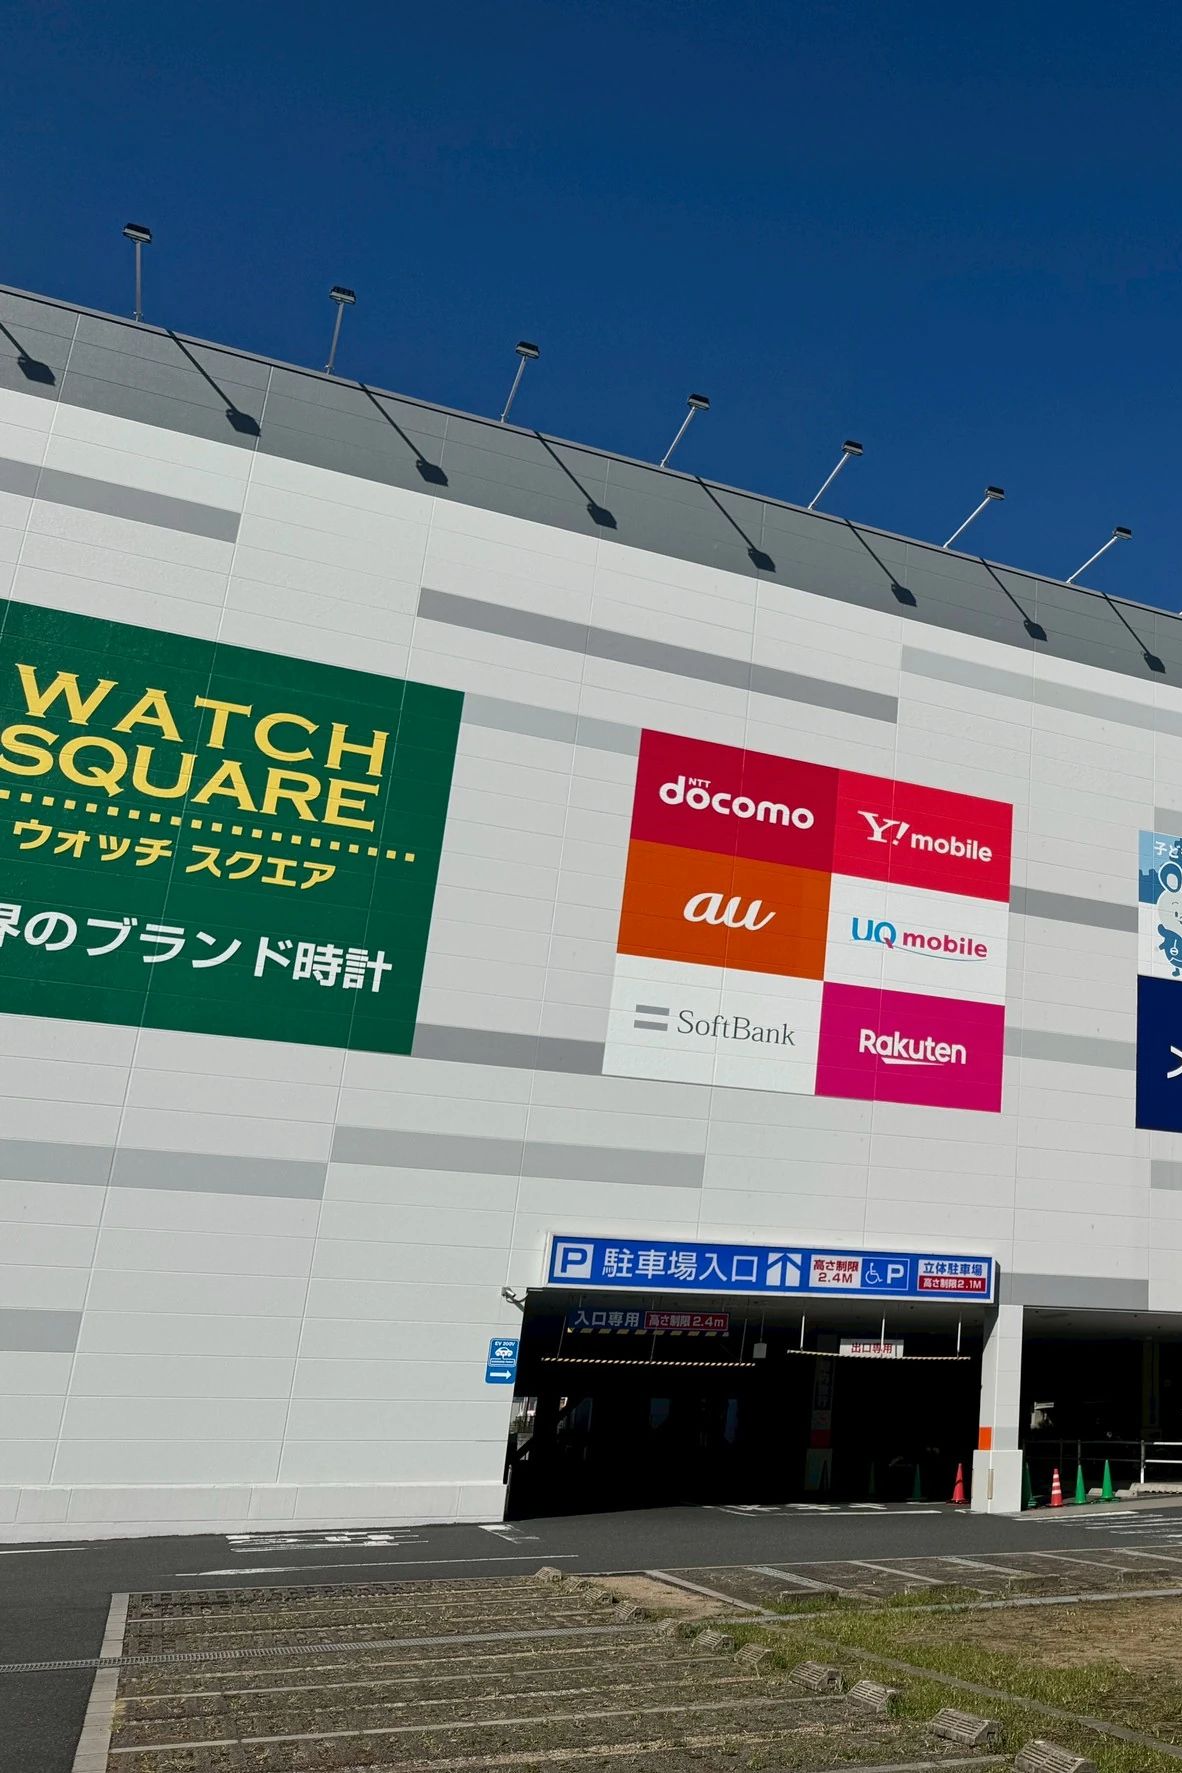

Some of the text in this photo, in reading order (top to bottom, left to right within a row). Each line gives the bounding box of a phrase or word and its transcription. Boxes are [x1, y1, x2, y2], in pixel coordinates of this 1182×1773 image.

[15, 663, 389, 777] WATCH
[0, 724, 380, 832] SQUARE
[689, 777, 711, 789] NTT
[659, 776, 815, 829] docomo
[13, 819, 336, 890] ウォッチ スクエア
[683, 892, 776, 931] au
[851, 917, 988, 958] UQ mobile
[677, 1009, 796, 1046] SoftBank
[859, 1029, 967, 1065] Rakuten
[602, 1248, 758, 1282] 駐車場入口
[814, 1259, 859, 1272] 高さ制限
[818, 1273, 852, 1283] 2.4M
[887, 1264, 904, 1284] P
[923, 1262, 982, 1275] 立体駐車場
[923, 1278, 982, 1289] 高さ制限2.1M
[574, 1310, 640, 1327] 入口専用
[851, 1343, 893, 1354] 出口専用
